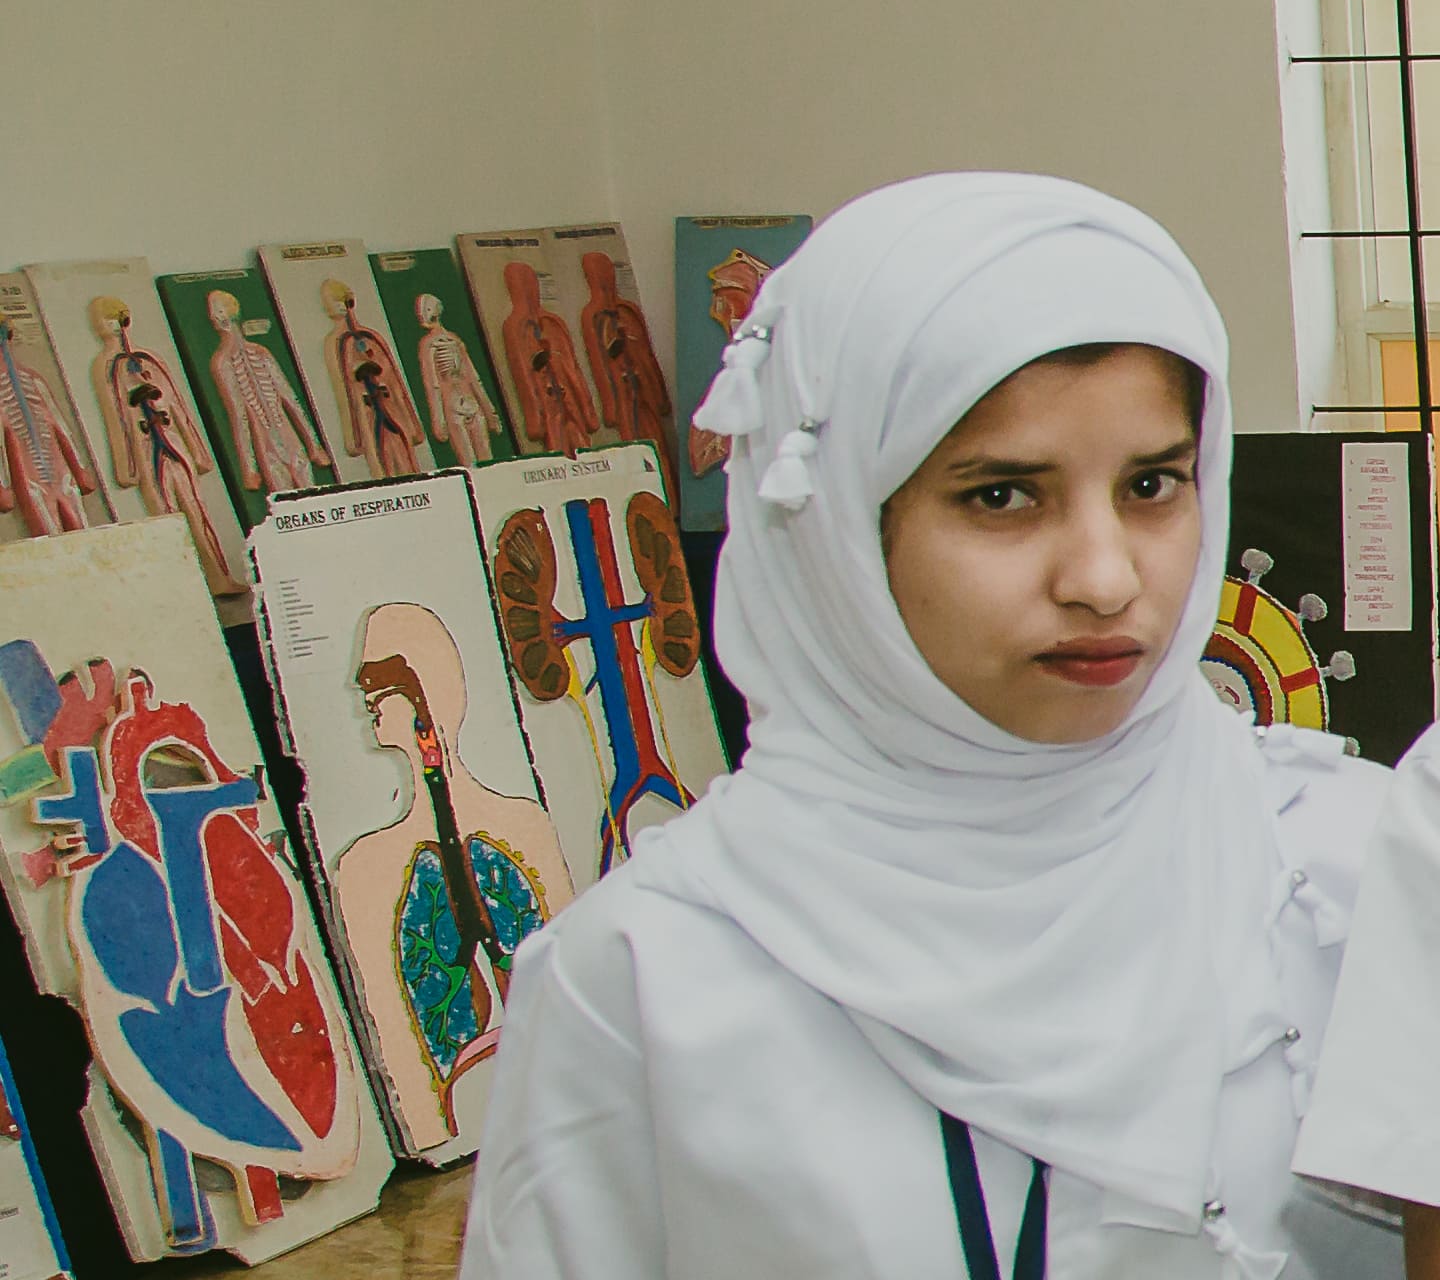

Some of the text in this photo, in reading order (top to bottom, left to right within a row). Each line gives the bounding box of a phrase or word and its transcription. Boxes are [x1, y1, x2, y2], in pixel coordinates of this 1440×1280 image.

[524, 460, 612, 484] URINARY SYSTEM
[275, 493, 431, 530] ORGANS OF RESPIRATION
